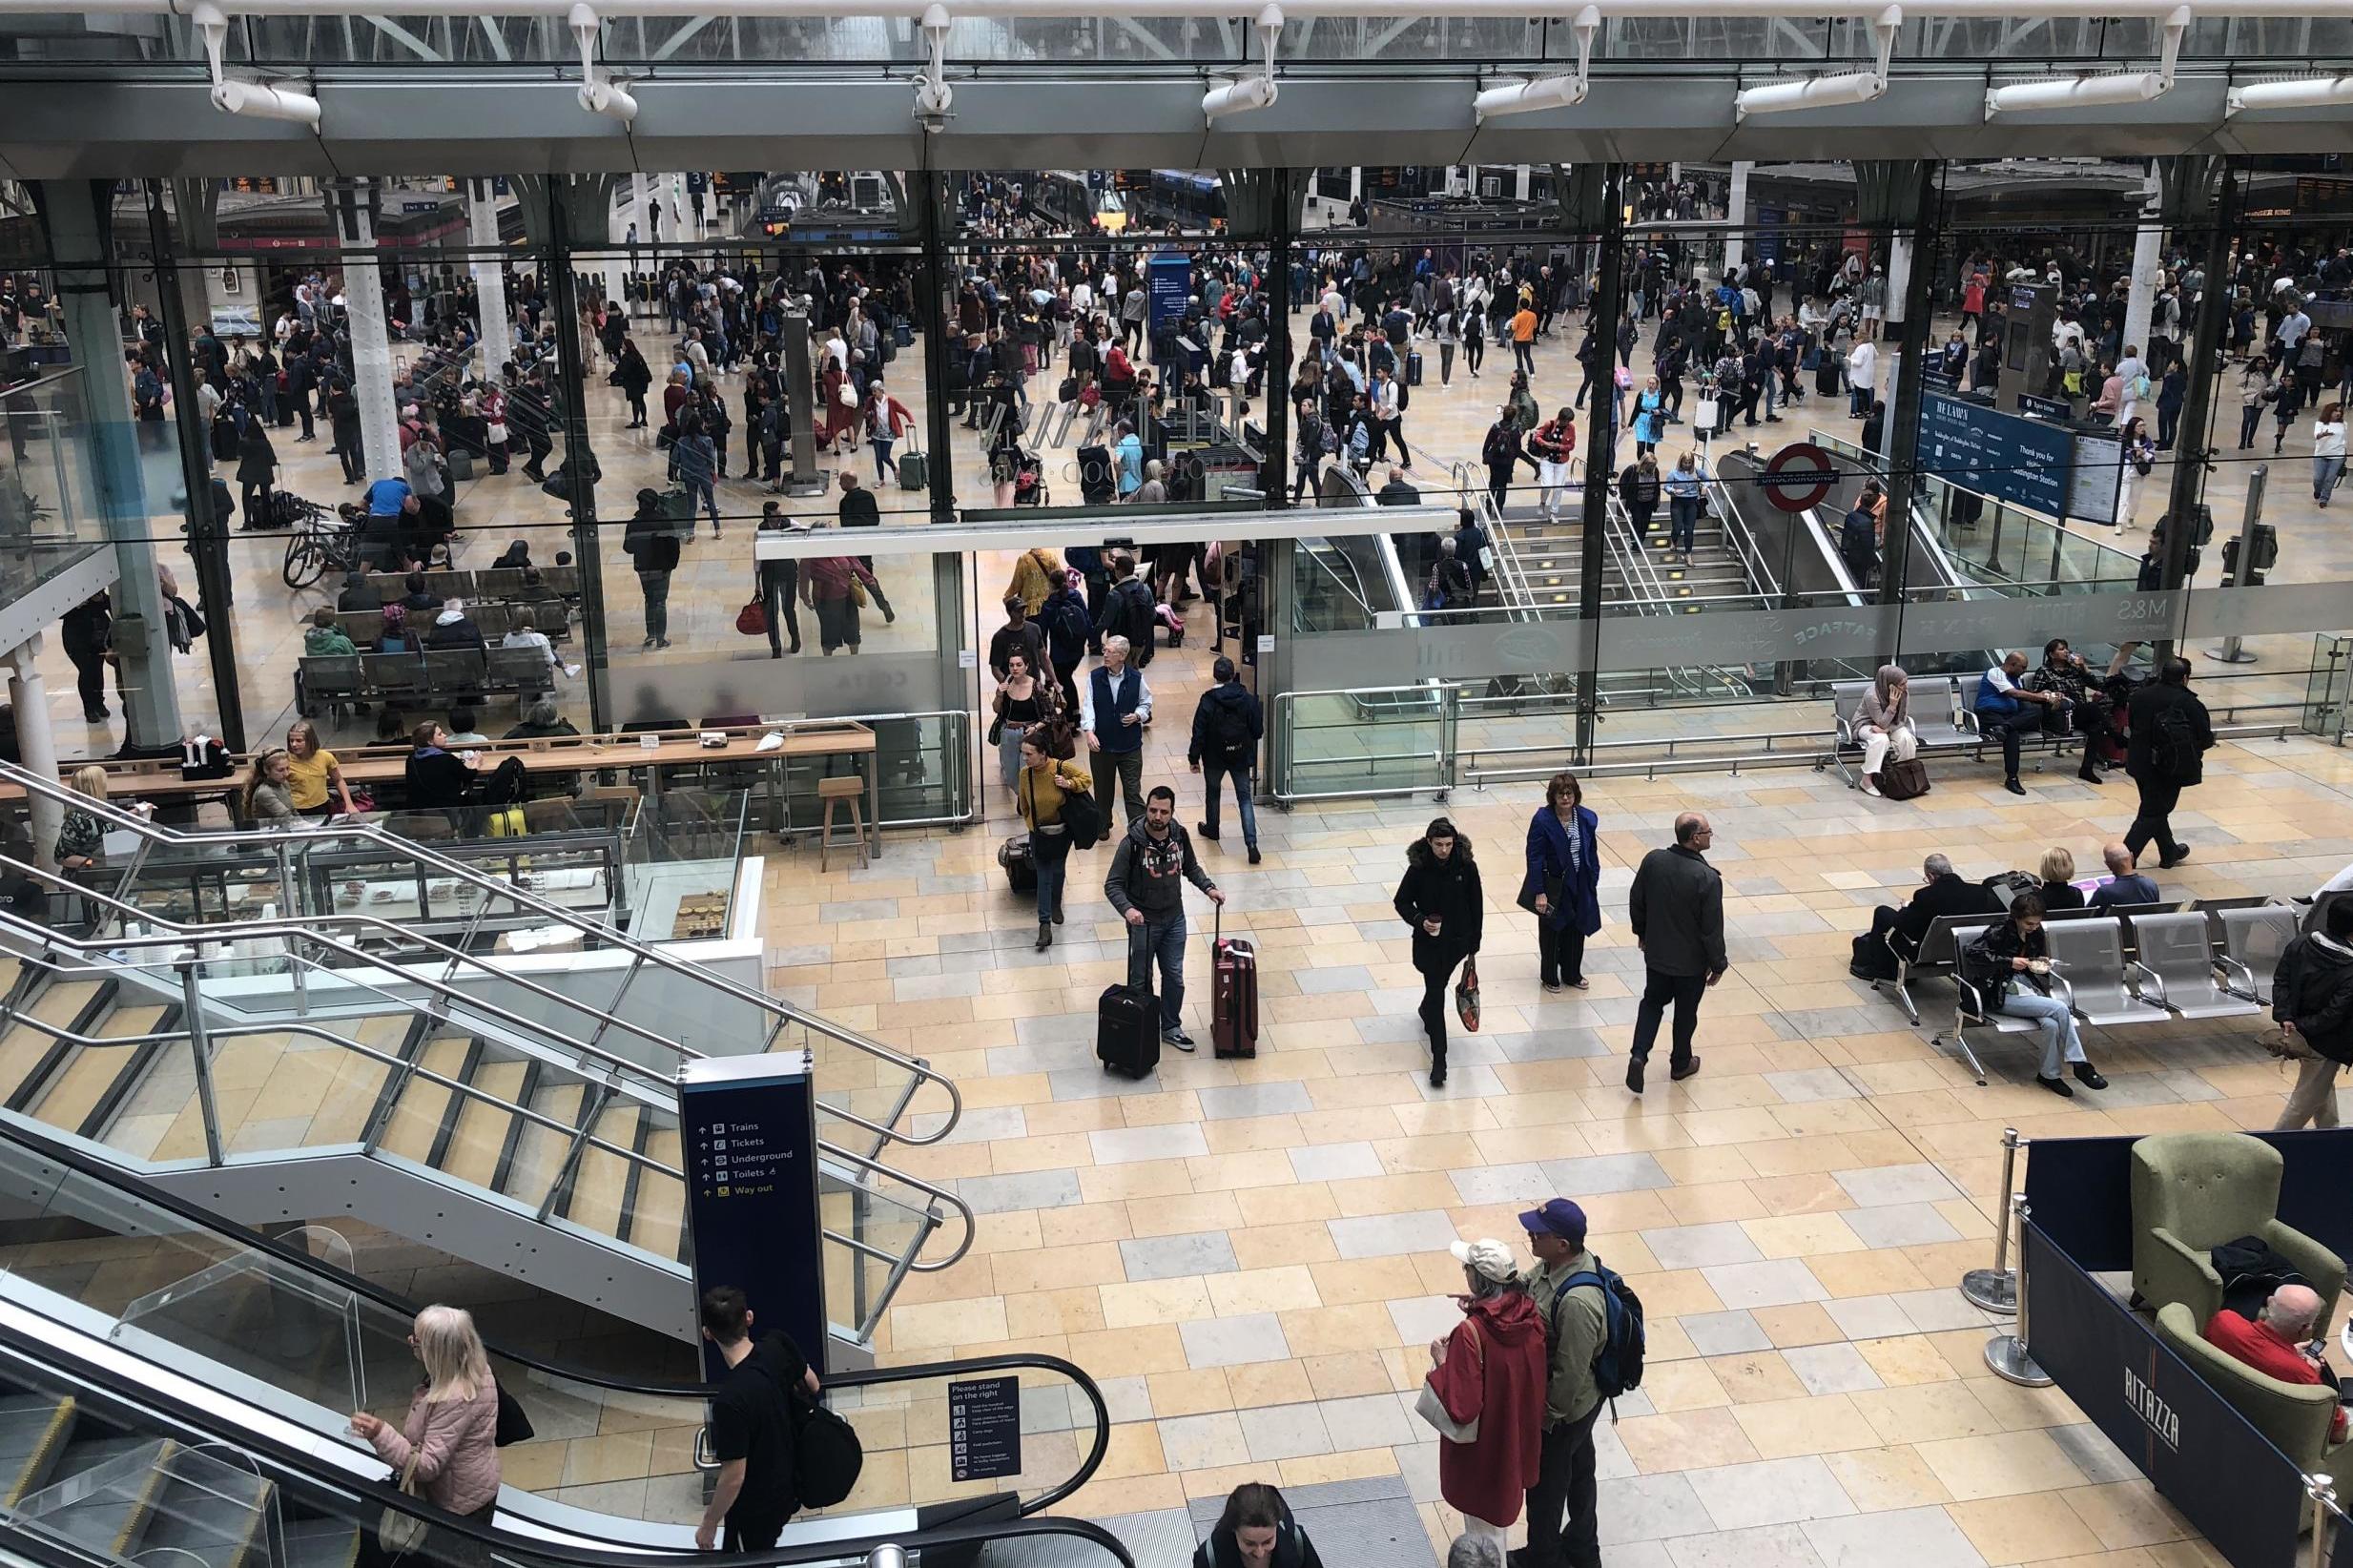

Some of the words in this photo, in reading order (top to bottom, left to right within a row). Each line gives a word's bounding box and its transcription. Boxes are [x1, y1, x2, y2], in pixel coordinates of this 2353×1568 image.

[692, 172, 701, 184] 3
[1092, 170, 1102, 181] 5
[1947, 404, 1970, 421] LAWN
[2019, 444, 2035, 457] Thank
[2046, 453, 2054, 463] for
[1762, 473, 1834, 484] UNDERGROUND
[2039, 474, 2058, 487] Station
[731, 1124, 760, 1132] Trains
[731, 1139, 765, 1147] Tickets
[731, 1150, 794, 1164] Underground
[733, 1169, 765, 1179] Toilets
[734, 1186, 755, 1195] Way
[757, 1185, 774, 1193] out
[952, 1385, 977, 1393] Please
[978, 1381, 1001, 1391] stand
[979, 1390, 999, 1399] right
[2125, 1366, 2179, 1448] RITAZZA
